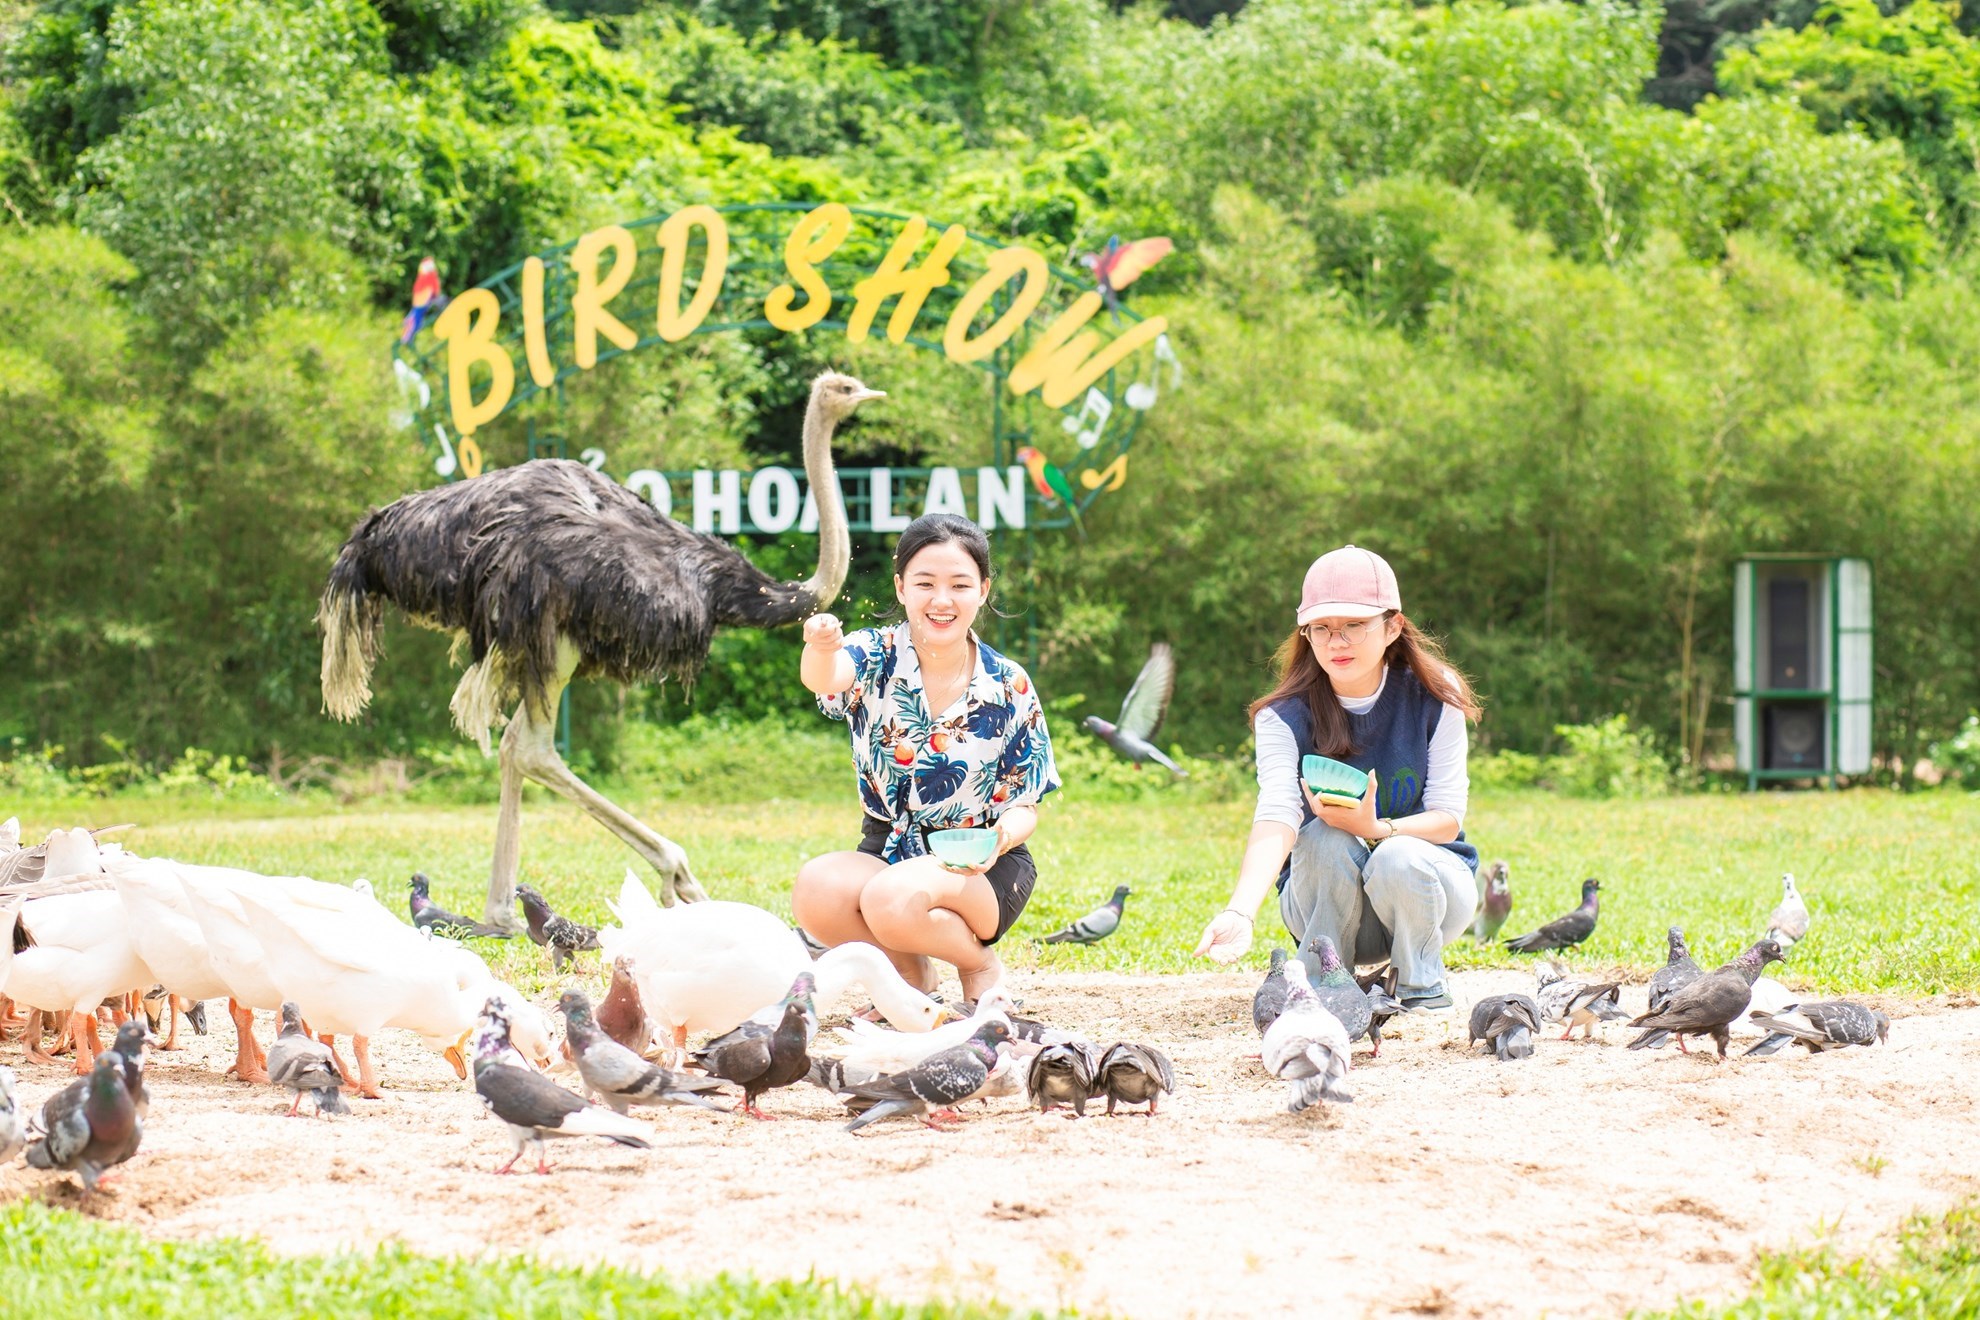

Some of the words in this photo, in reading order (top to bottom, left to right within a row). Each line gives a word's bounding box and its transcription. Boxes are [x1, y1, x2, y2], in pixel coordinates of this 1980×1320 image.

[433, 204, 729, 436] BIRD
[764, 202, 1168, 408] SHOW
[870, 465, 1026, 532] LAN
